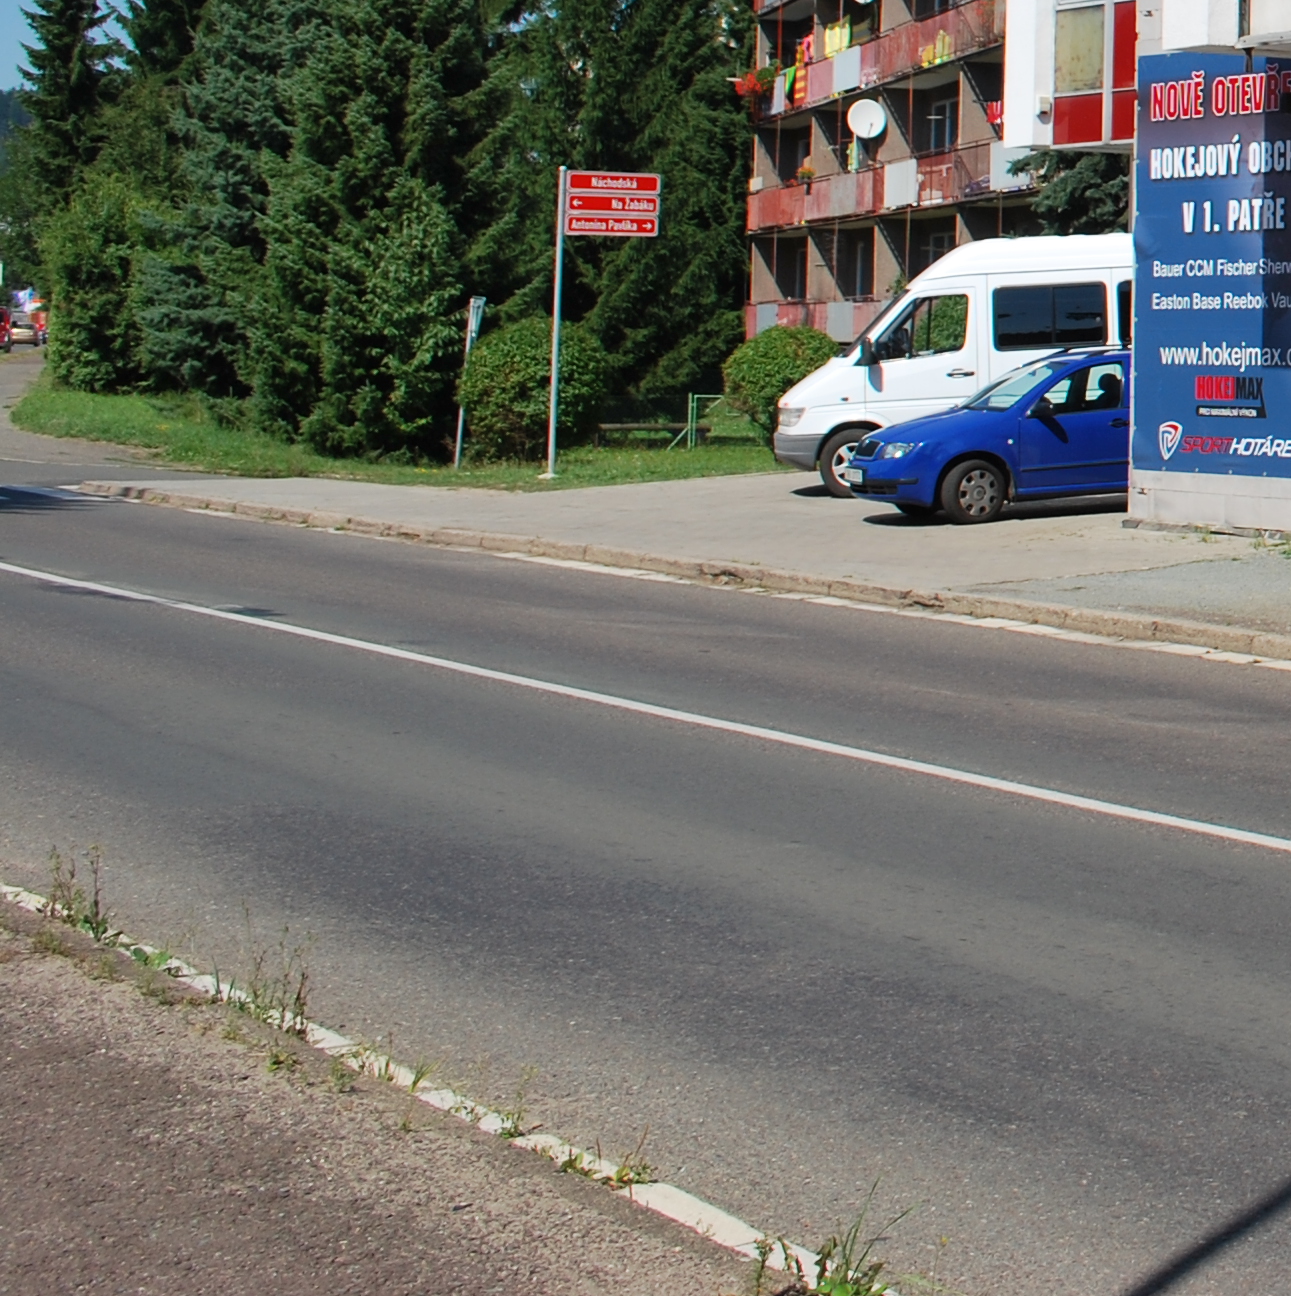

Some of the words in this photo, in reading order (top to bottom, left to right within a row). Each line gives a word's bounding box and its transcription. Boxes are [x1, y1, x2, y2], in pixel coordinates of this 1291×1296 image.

[1150, 70, 1205, 122] NOVĚ
[1149, 133, 1242, 180] HOKEJOVÝ
[1182, 202, 1196, 234] V
[1203, 200, 1220, 232] 1.
[1227, 190, 1286, 232] PATŘE
[1153, 260, 1185, 277] Bauer
[1186, 259, 1213, 277] CCM
[1216, 259, 1259, 276] Fischer
[1152, 292, 1191, 310] Easton
[1192, 292, 1221, 310] Base
[1223, 291, 1269, 310] Reebok
